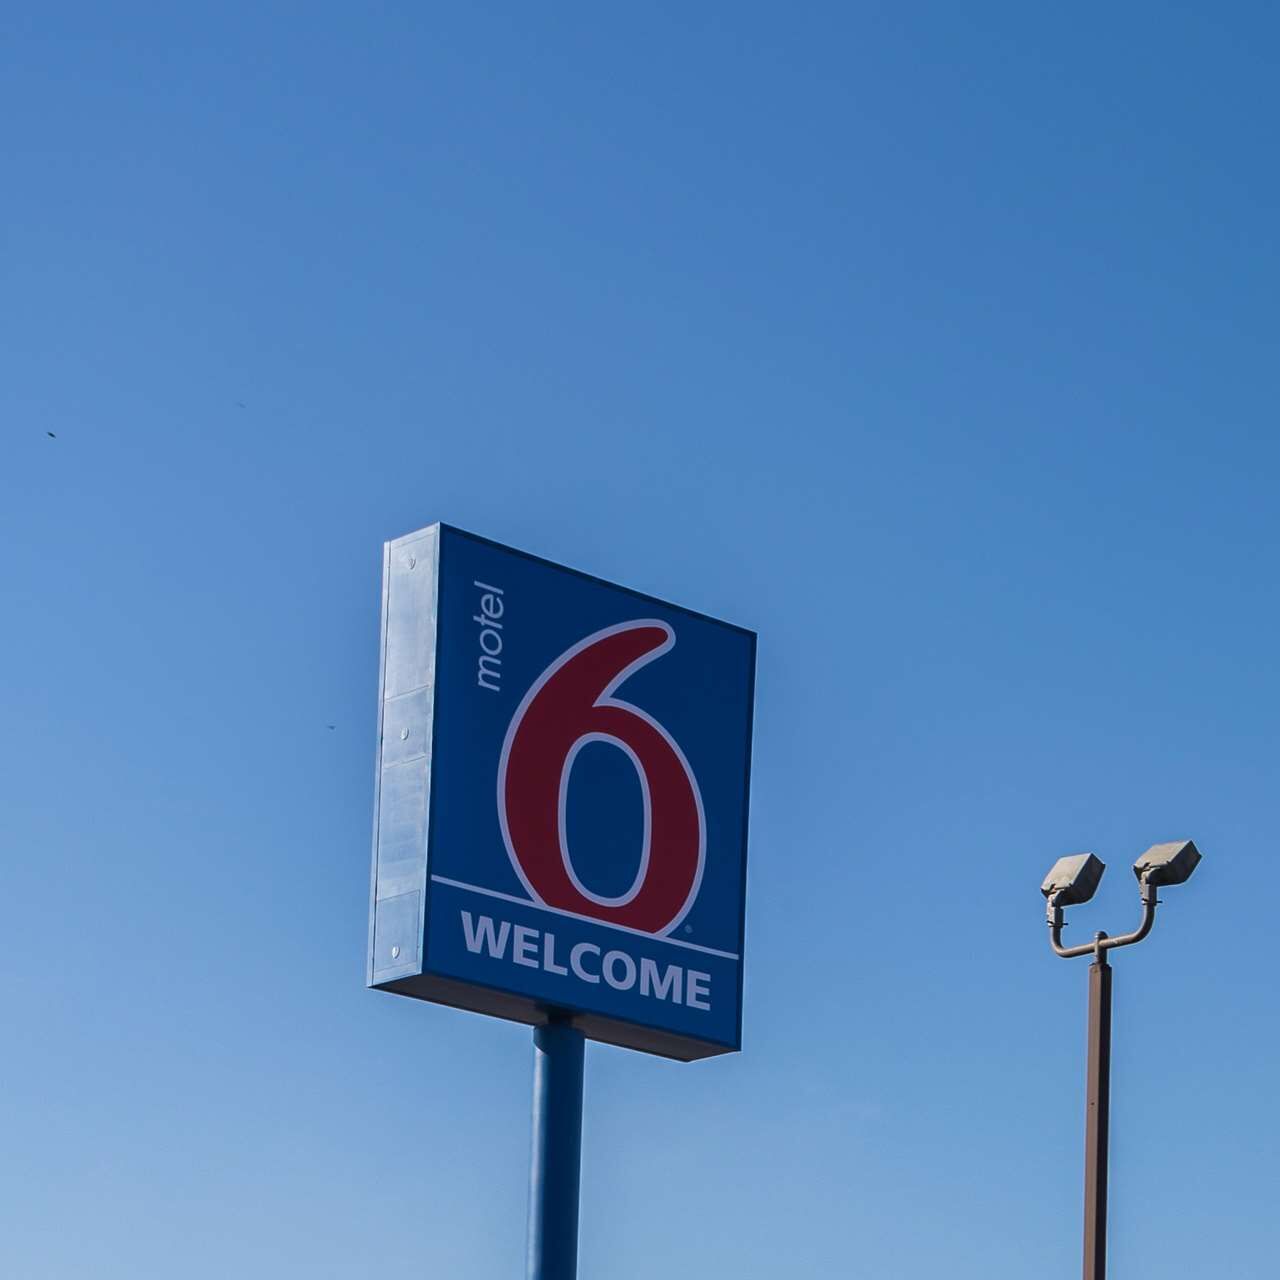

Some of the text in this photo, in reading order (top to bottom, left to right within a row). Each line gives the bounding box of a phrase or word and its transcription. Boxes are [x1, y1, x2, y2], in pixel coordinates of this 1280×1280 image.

[473, 579, 505, 692] motel
[497, 618, 707, 939] 6
[460, 909, 712, 1012] WELCOME
